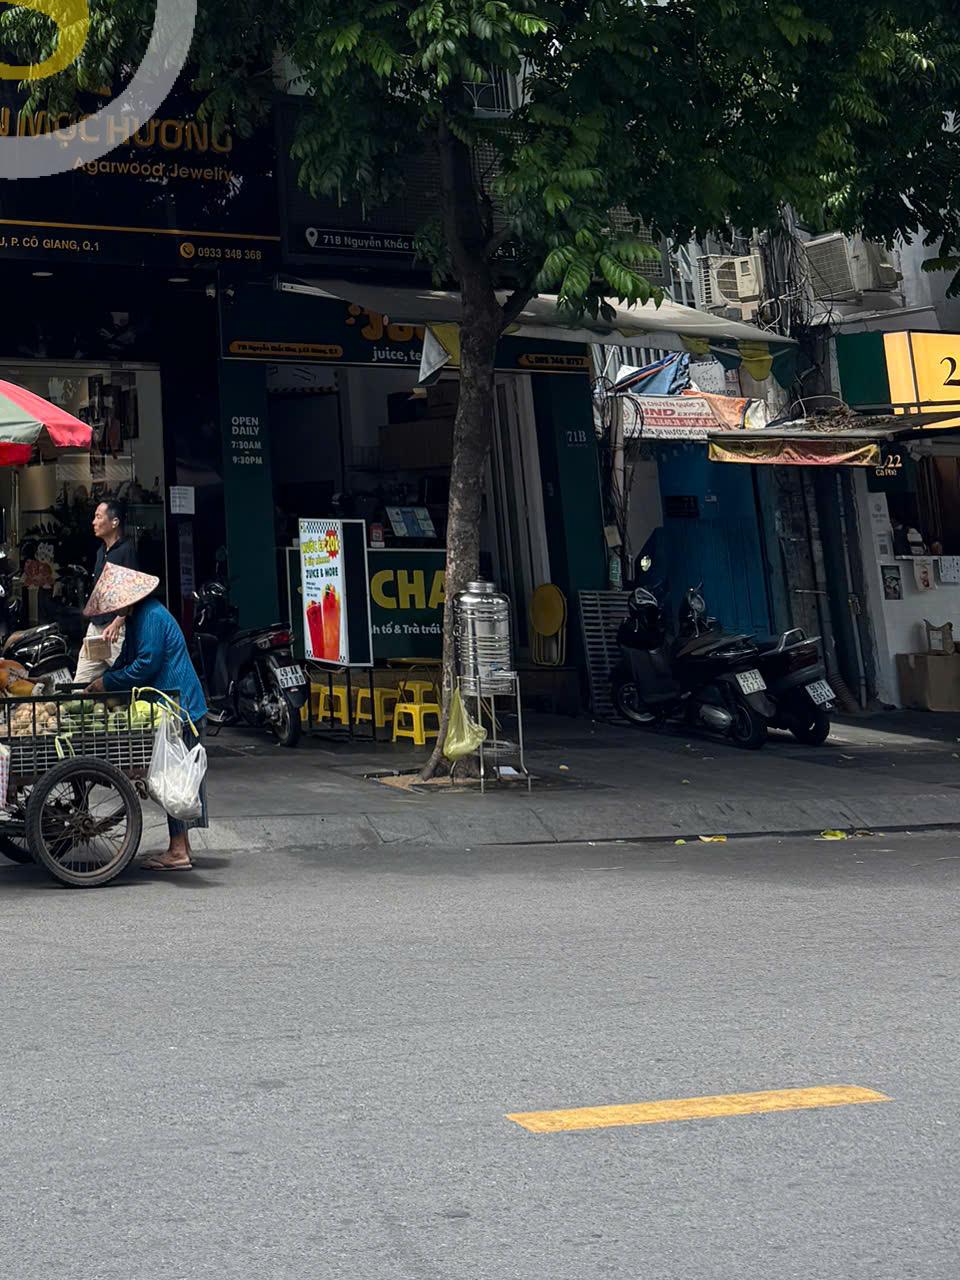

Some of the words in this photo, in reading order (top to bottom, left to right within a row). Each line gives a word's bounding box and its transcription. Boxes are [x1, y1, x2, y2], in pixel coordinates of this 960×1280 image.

[105, 113, 234, 154] HƯƠNG
[73, 159, 166, 179] Agarwood
[169, 162, 234, 183] Jewelry
[10, 236, 21, 248] P.
[22, 235, 40, 249] CÔ
[42, 239, 81, 253] GIANG,
[82, 240, 100, 253] Q.1
[344, 235, 382, 251] Nguyễn
[197, 247, 222, 258] 0933
[372, 346, 407, 361] juice,
[409, 349, 424, 361] te
[231, 416, 259, 426] OPEN
[231, 426, 260, 436] DAILY
[567, 429, 587, 443] 71B
[231, 440, 262, 449] 7:30AM
[232, 455, 263, 465] 9:30PM
[382, 620, 393, 635] tố
[393, 624, 402, 634] &
[402, 622, 420, 635] Trà
[420, 622, 442, 635] trái
